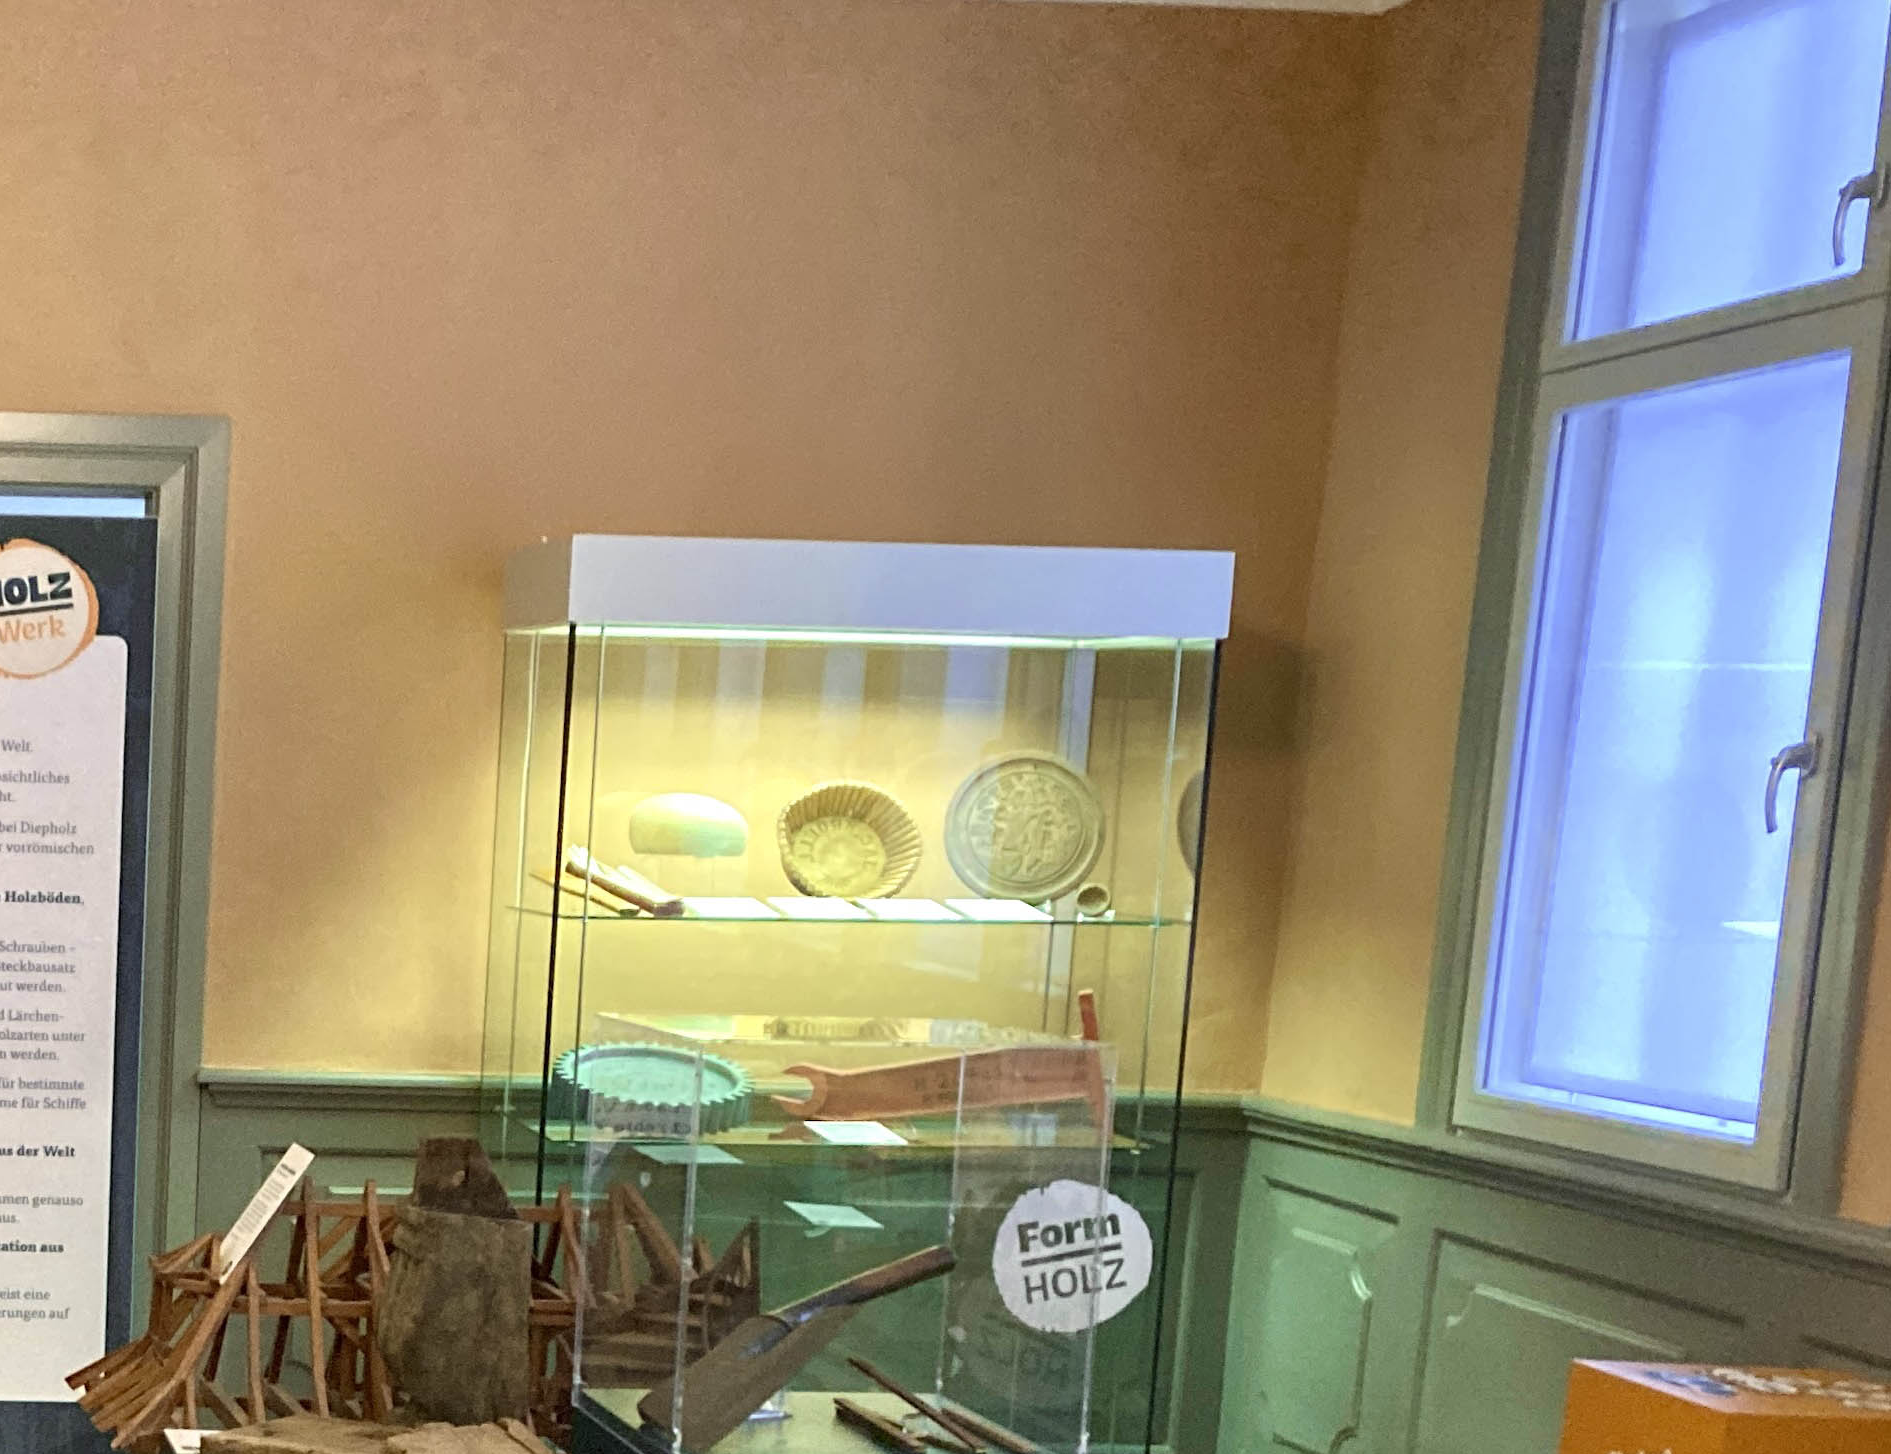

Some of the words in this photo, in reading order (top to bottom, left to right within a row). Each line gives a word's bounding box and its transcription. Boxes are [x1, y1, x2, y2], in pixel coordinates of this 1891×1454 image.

[19, 821, 77, 838] Diepholz
[6, 1009, 63, 1023] Lärchen-
[50, 1029, 87, 1042] unter
[16, 1077, 85, 1091] bestimmte
[41, 1097, 86, 1110] Schiffe
[15, 1144, 39, 1156] der
[42, 1145, 75, 1157] Welt
[31, 1197, 83, 1208] genauso
[1017, 1213, 1121, 1254] Form
[39, 1244, 64, 1253] aus
[1024, 1258, 1127, 1304] HOLZ
[22, 1288, 51, 1300] eine
